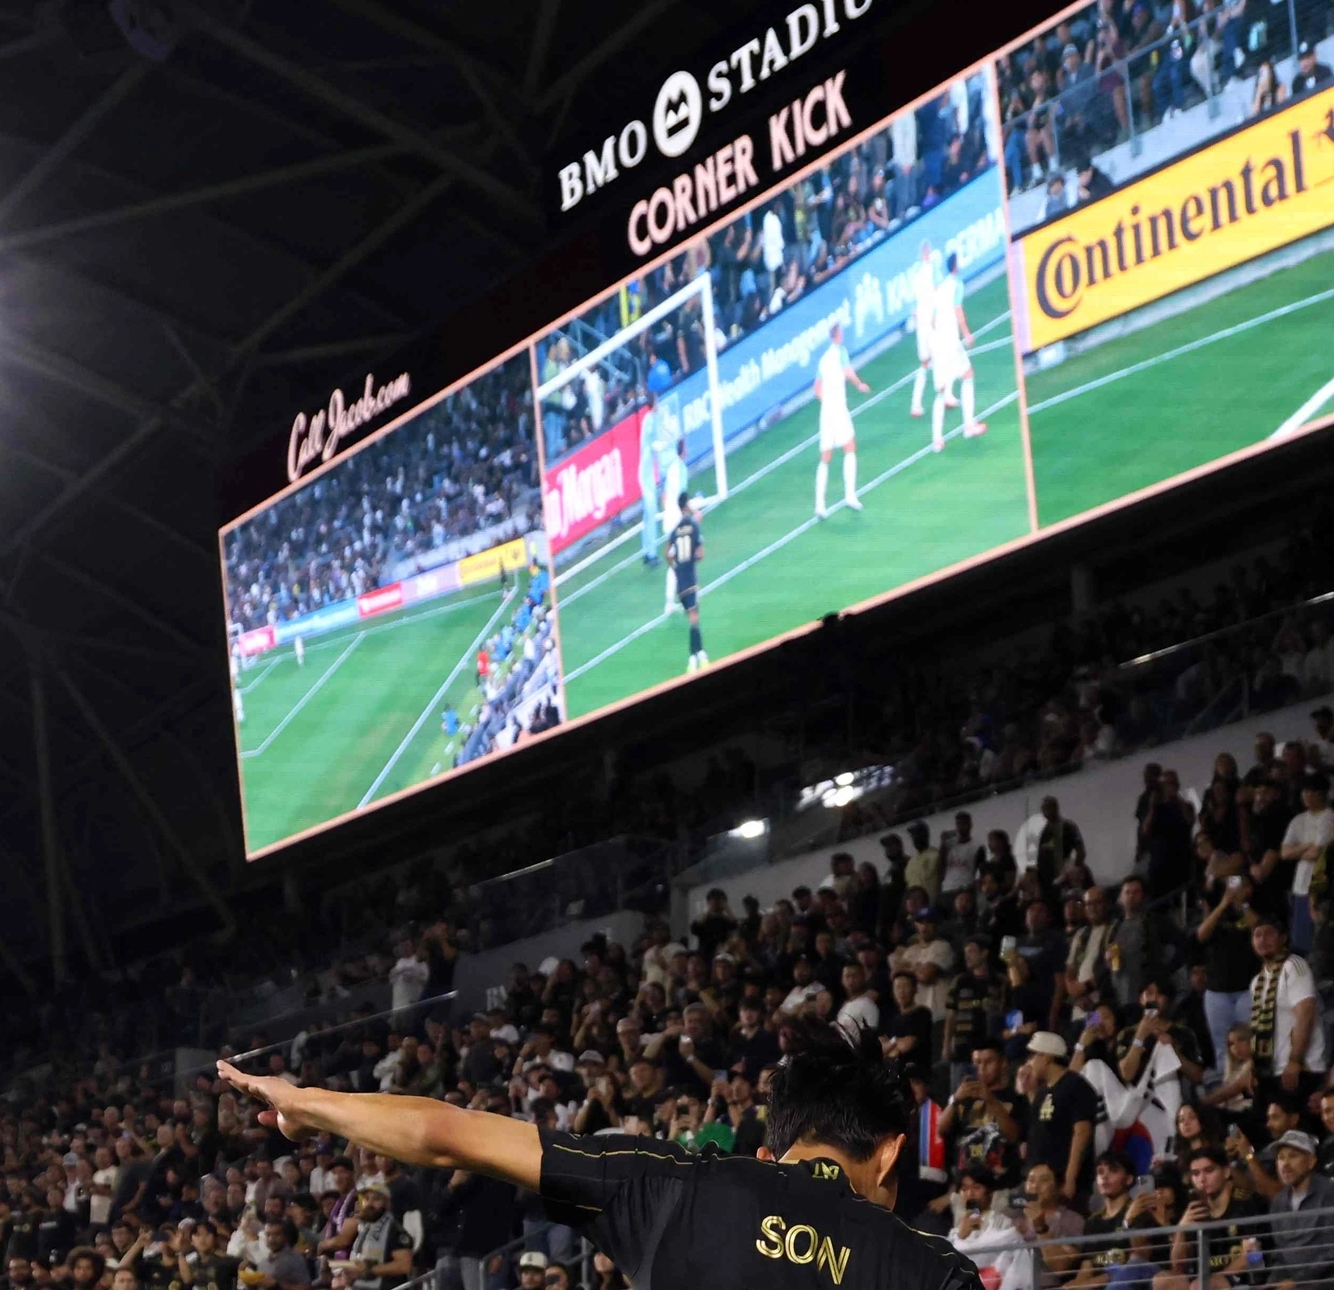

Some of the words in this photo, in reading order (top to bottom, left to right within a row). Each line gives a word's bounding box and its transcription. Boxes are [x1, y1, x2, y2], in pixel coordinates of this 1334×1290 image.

[558, 119, 648, 212] BMO
[628, 133, 760, 256] CORNER
[768, 69, 853, 172] KICK
[1035, 127, 1308, 319] Continental
[755, 1214, 851, 1286] SON
